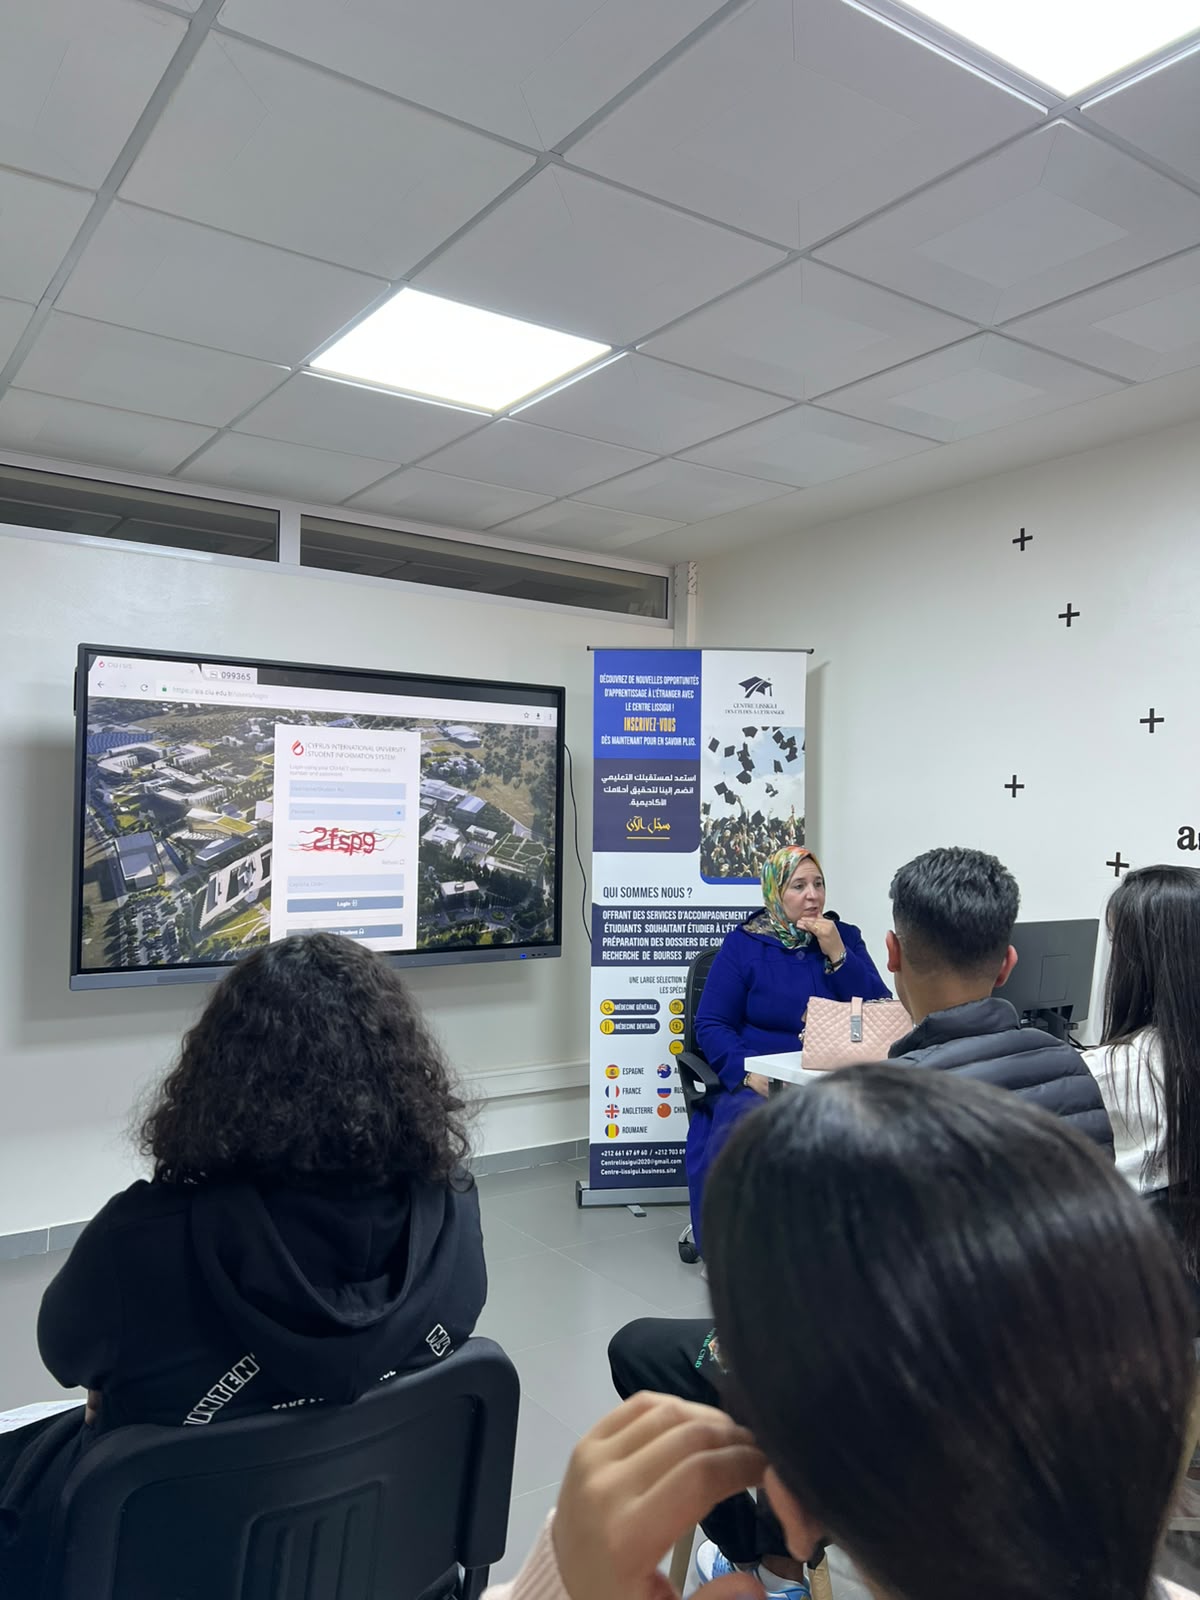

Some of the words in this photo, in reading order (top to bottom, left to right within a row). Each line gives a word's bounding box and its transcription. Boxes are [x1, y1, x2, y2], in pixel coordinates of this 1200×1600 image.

[221, 671, 252, 681] 099365
[600, 673, 627, 684] DÉCOUVREZ
[628, 675, 635, 684] DE
[636, 675, 663, 685] NOUVELLES
[664, 675, 700, 686] OPPORTUNITÉS
[681, 690, 695, 699] AVEC
[625, 702, 632, 711] LE
[632, 702, 651, 712] CENTRE
[624, 717, 677, 732] INSCRIVEZ-VOUS
[612, 736, 643, 745] MAINTENANT
[643, 737, 657, 746] POUR
[657, 737, 665, 746] EN
[665, 737, 682, 746] SAVOIR
[682, 737, 697, 746] PLUS.
[307, 742, 330, 750] CYPRUS
[331, 743, 375, 752] INTERNATIONAL
[375, 745, 407, 753] UNIVERSITY
[307, 750, 334, 758] STUDENT
[335, 751, 375, 760] INFORMATION
[375, 753, 396, 761] SYSTEM
[601, 773, 634, 783] التعليمي
[634, 774, 673, 784] لمستقبلك
[674, 774, 697, 782] استعد
[603, 784, 629, 794] أحلامك
[629, 785, 658, 795] لتحقيق
[673, 786, 694, 796] انضم
[1177, 826, 1200, 851] a
[603, 886, 618, 899] QUI
[620, 886, 659, 899] SOMMES
[661, 887, 685, 898] NOUS
[687, 887, 693, 899] ?
[602, 910, 632, 920] OFFRANT
[632, 910, 646, 920] DES
[646, 910, 677, 920] SERVICES
[678, 910, 747, 920] D'ACCOMPAGNEMENT
[604, 922, 642, 934] ÉTUDIANTS
[644, 924, 686, 934] SOUHAITANT
[687, 922, 715, 934] ÉTUDIER
[715, 921, 721, 934] À
[602, 936, 649, 947] PRÉPARATION
[650, 937, 664, 947] DES
[665, 937, 698, 947] DOSSIERS
[699, 938, 709, 947] DE
[602, 950, 639, 960] RECHERCHE
[642, 951, 650, 960] DE
[653, 951, 682, 960] BOURSES
[629, 976, 639, 984] UNE
[640, 976, 655, 984] LARGE
[660, 986, 669, 994] LES
[622, 1067, 645, 1076] ESPAGNE
[622, 1087, 642, 1095] FRANCE
[622, 1107, 654, 1115] ANGLETERRE
[622, 1126, 648, 1134] ROUMANIE
